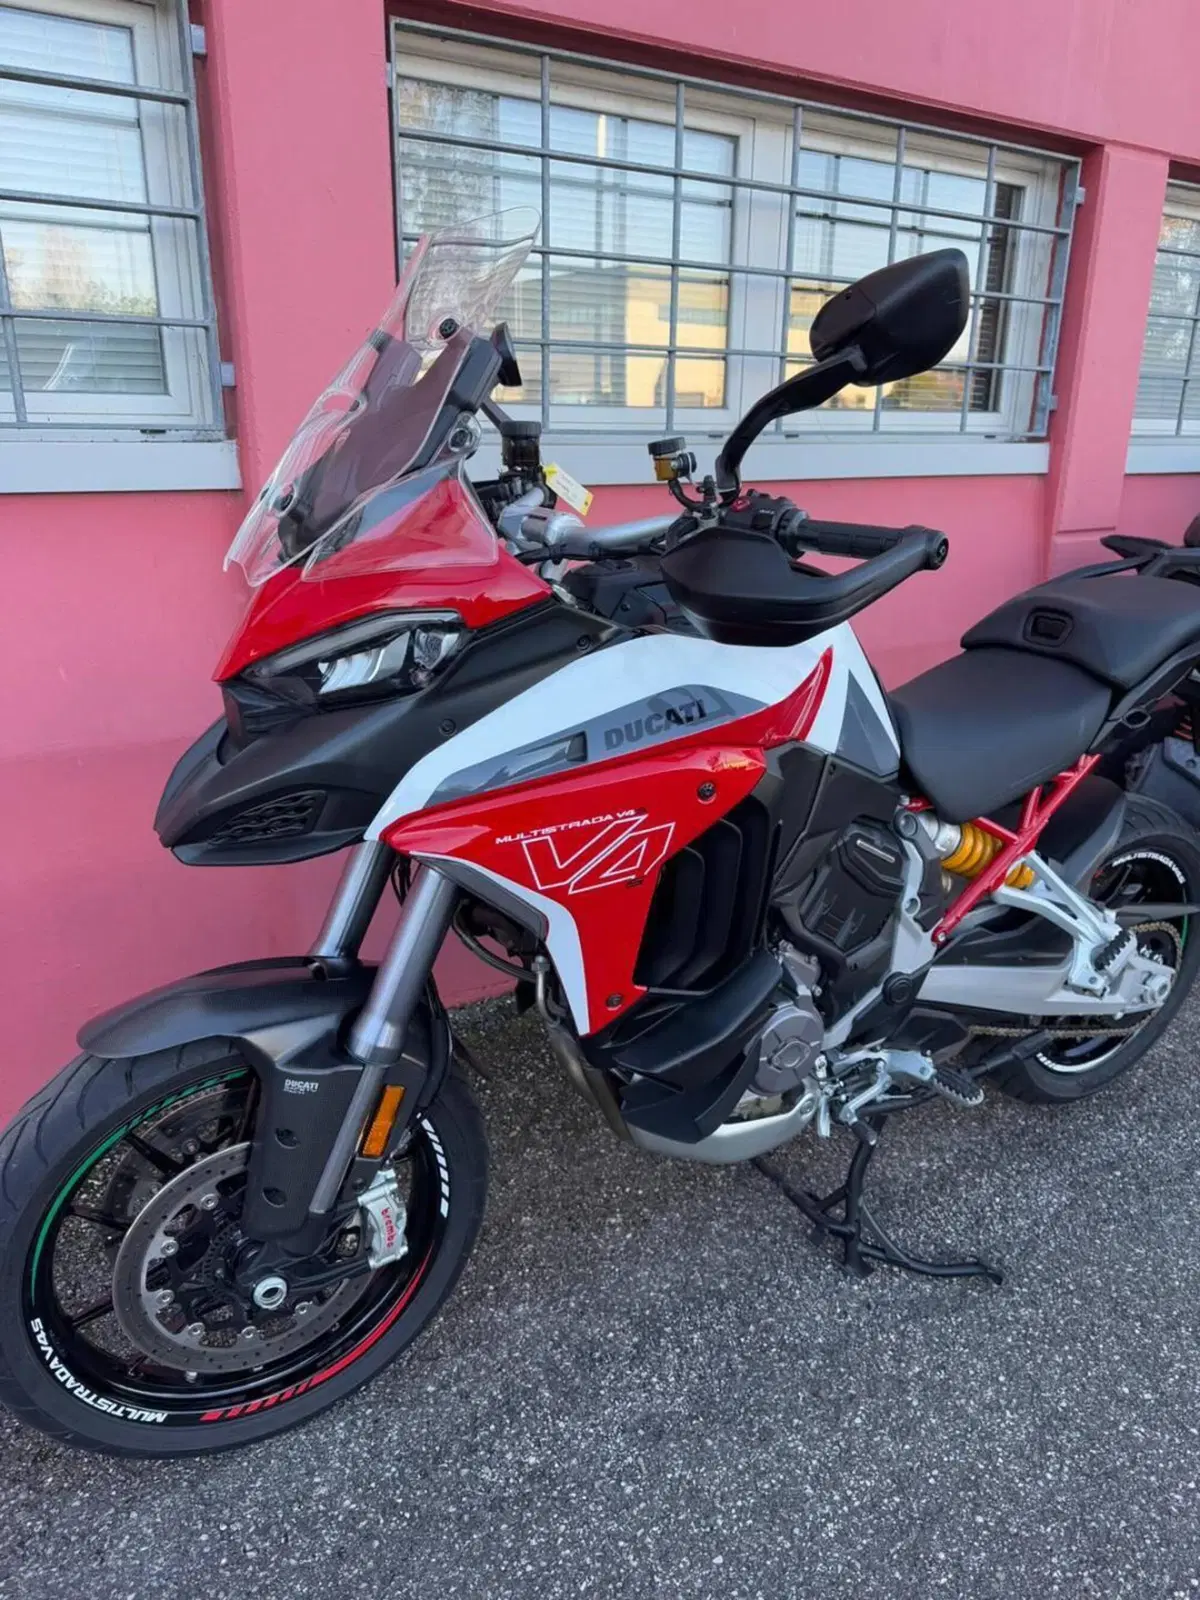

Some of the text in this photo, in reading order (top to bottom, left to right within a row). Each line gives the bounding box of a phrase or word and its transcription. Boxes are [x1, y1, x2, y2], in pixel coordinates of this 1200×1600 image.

[603, 698, 708, 751] DUCATI
[495, 808, 637, 845] MULTISTRADA V4
[284, 1078, 319, 1092] DUCATI
